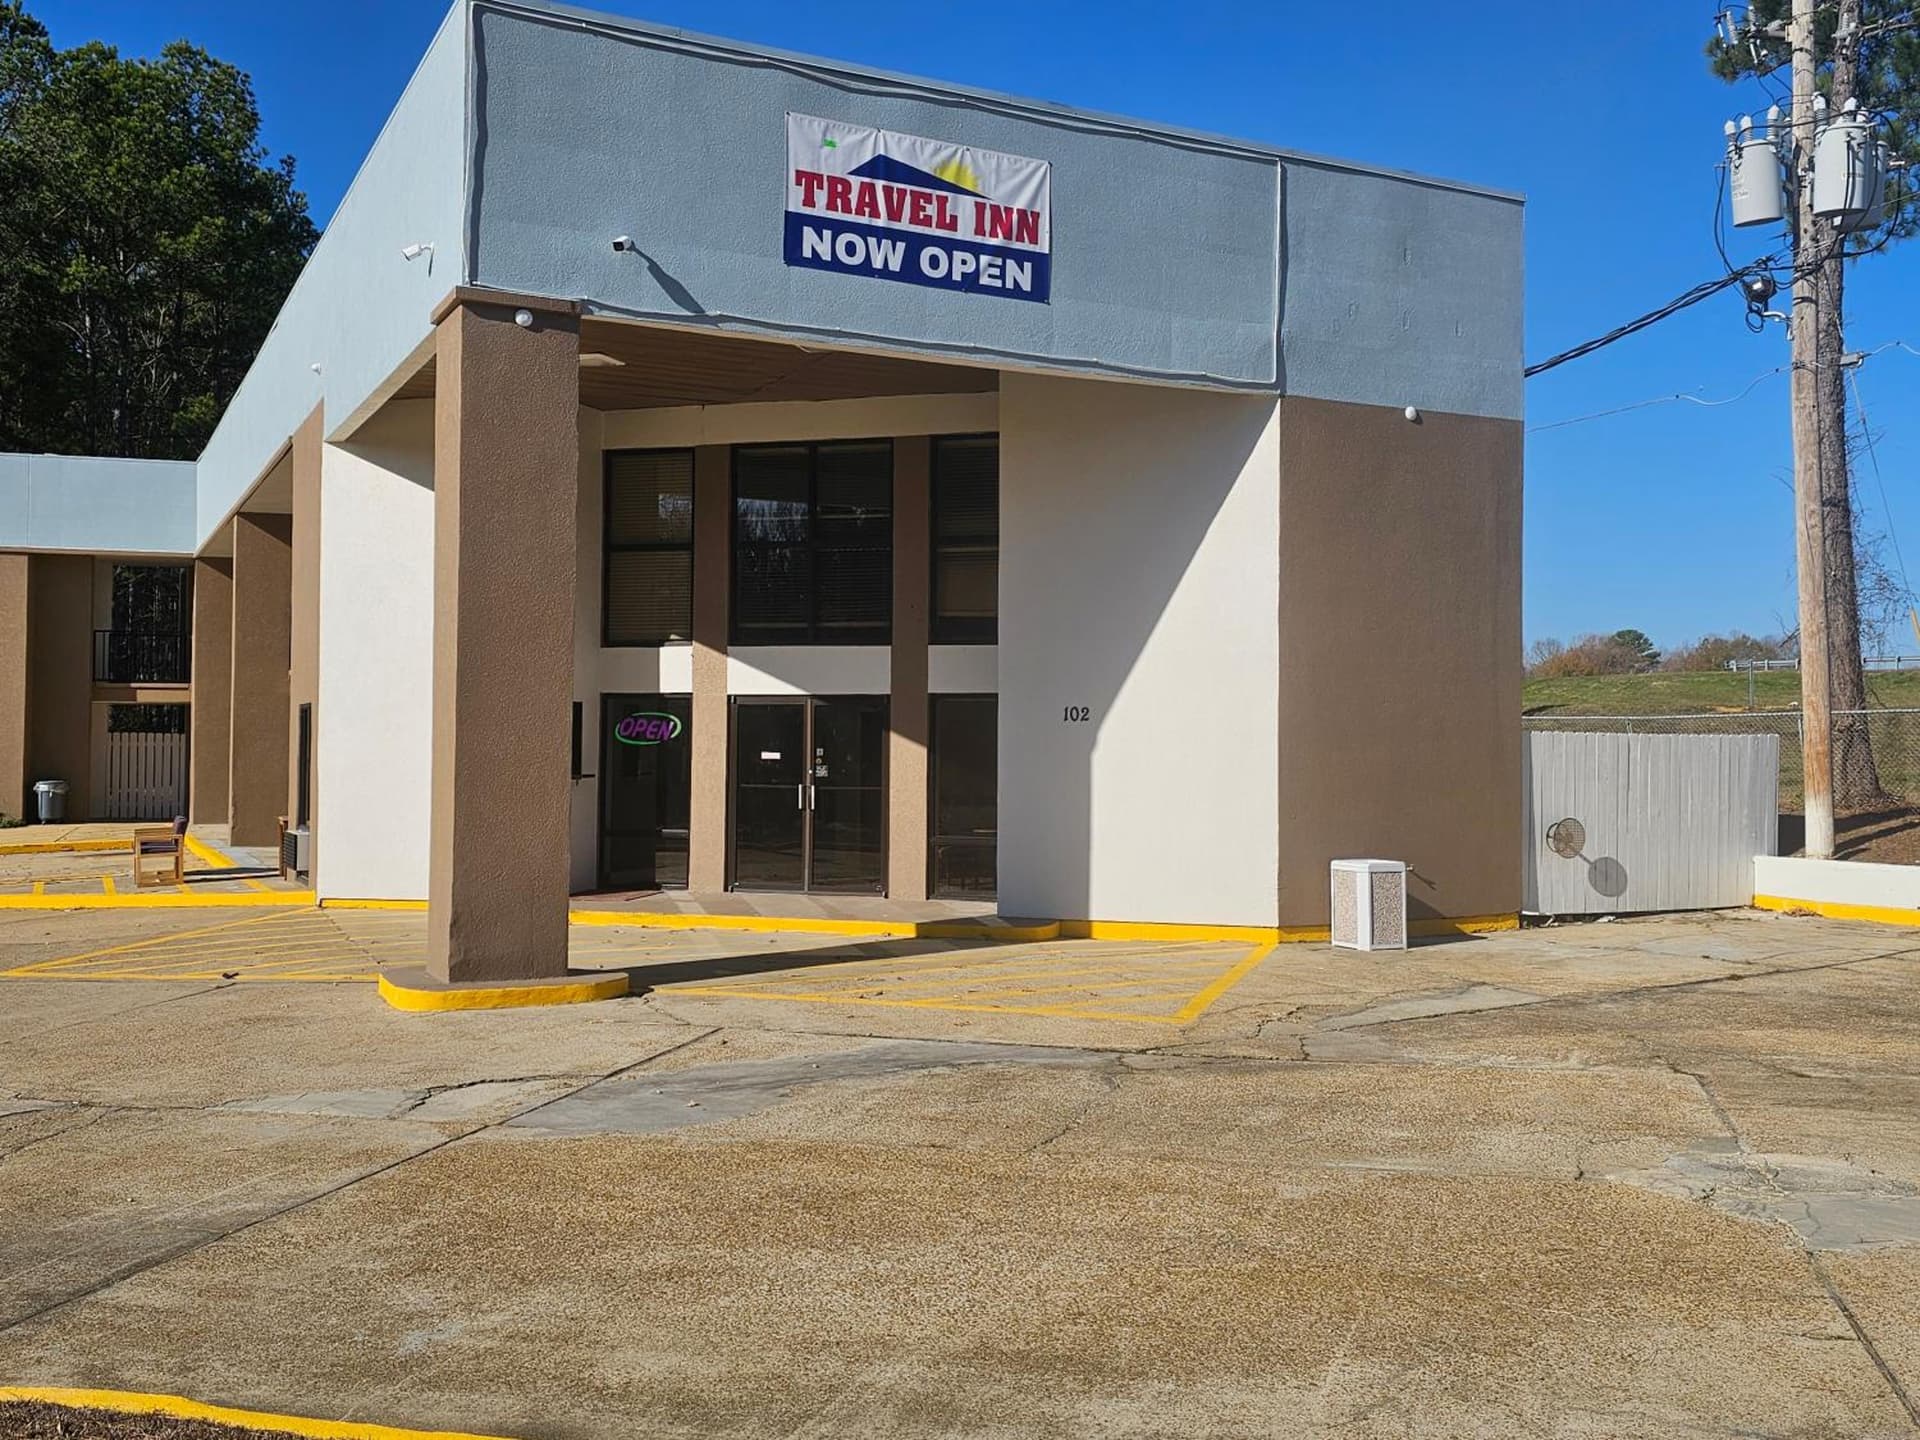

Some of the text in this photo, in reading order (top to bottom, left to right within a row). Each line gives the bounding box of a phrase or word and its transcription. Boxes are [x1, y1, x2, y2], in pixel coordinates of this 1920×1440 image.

[795, 169, 1040, 245] TRAVEL INN
[802, 226, 1032, 292] NOW OPEN
[620, 717, 674, 740] OPEN
[1064, 706, 1089, 721] 102
